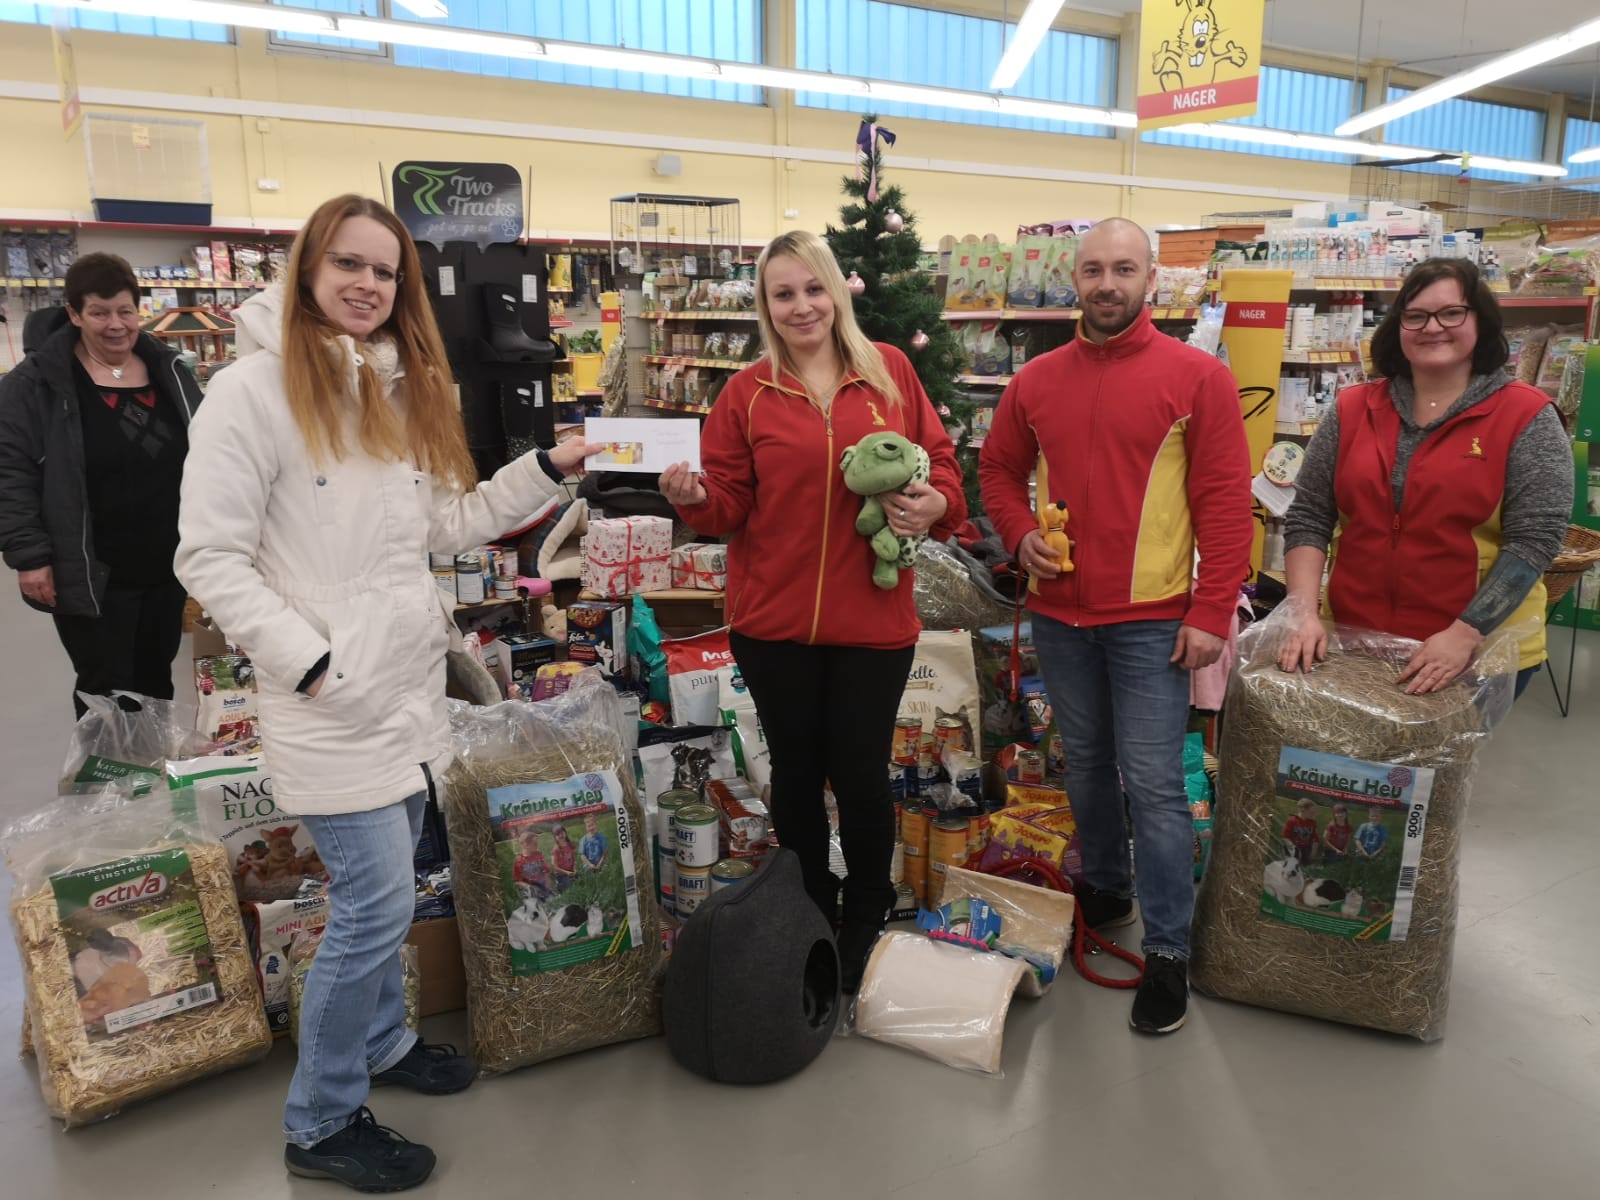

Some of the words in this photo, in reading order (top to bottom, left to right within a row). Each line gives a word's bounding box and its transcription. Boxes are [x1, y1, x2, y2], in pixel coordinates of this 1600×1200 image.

[1172, 88, 1217, 110] NAGER
[450, 175, 495, 196] Two
[447, 195, 517, 217] Tracks
[1239, 309, 1266, 319] NAGER
[223, 697, 246, 706] bosch
[908, 701, 932, 713] SKIN
[1288, 763, 1359, 791] Kräuter
[1364, 777, 1403, 799] Heu
[501, 796, 568, 819] Kräuter
[572, 788, 604, 806] Heu
[1407, 811, 1420, 839] 5000
[1414, 803, 1425, 811] g
[617, 816, 629, 849] 2000
[1013, 825, 1052, 845] Josera
[93, 863, 151, 882] EINSTREU
[94, 869, 162, 908] activa
[293, 897, 325, 910] bosch
[275, 919, 302, 936] MINI
